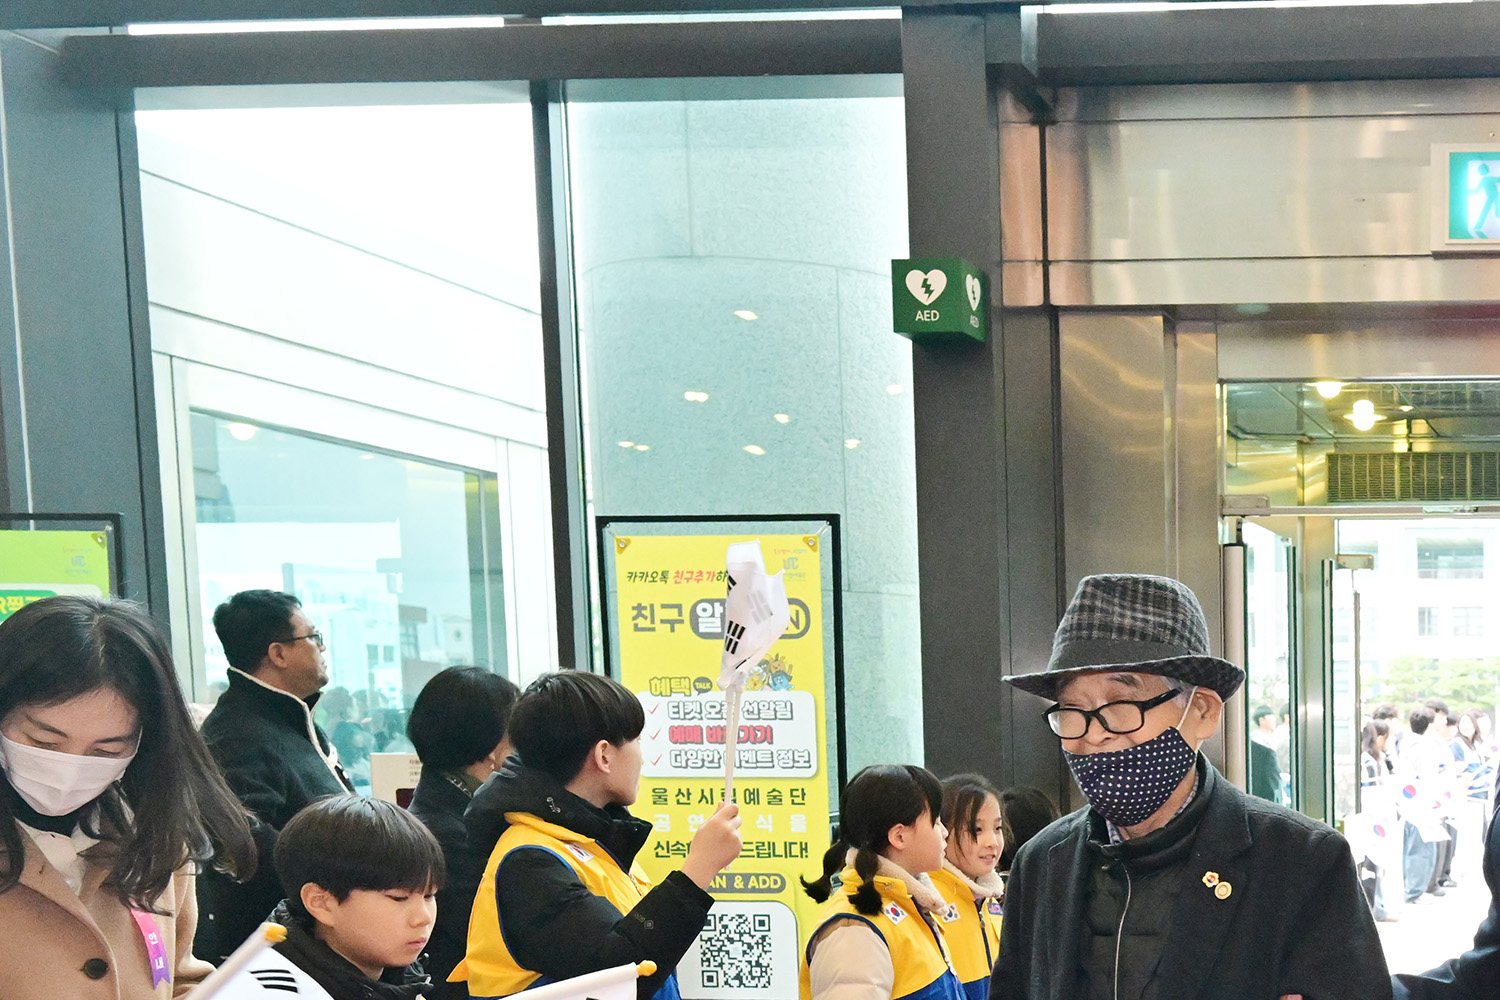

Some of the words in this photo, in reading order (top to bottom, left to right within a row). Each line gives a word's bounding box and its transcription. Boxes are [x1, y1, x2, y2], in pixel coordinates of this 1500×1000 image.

[915, 310, 940, 321] AED
[627, 570, 669, 584] 카카오톡
[631, 602, 684, 633] 친구
[649, 676, 691, 697] 혜택
[695, 682, 711, 690] TALK
[668, 701, 703, 720] 티켓
[742, 700, 793, 720] 선알림
[669, 725, 703, 744] 예매
[706, 725, 773, 744] 바가기
[670, 749, 721, 769] 다양한
[777, 749, 811, 769] 정보
[734, 873, 744, 889] &
[748, 876, 782, 888] ADD
